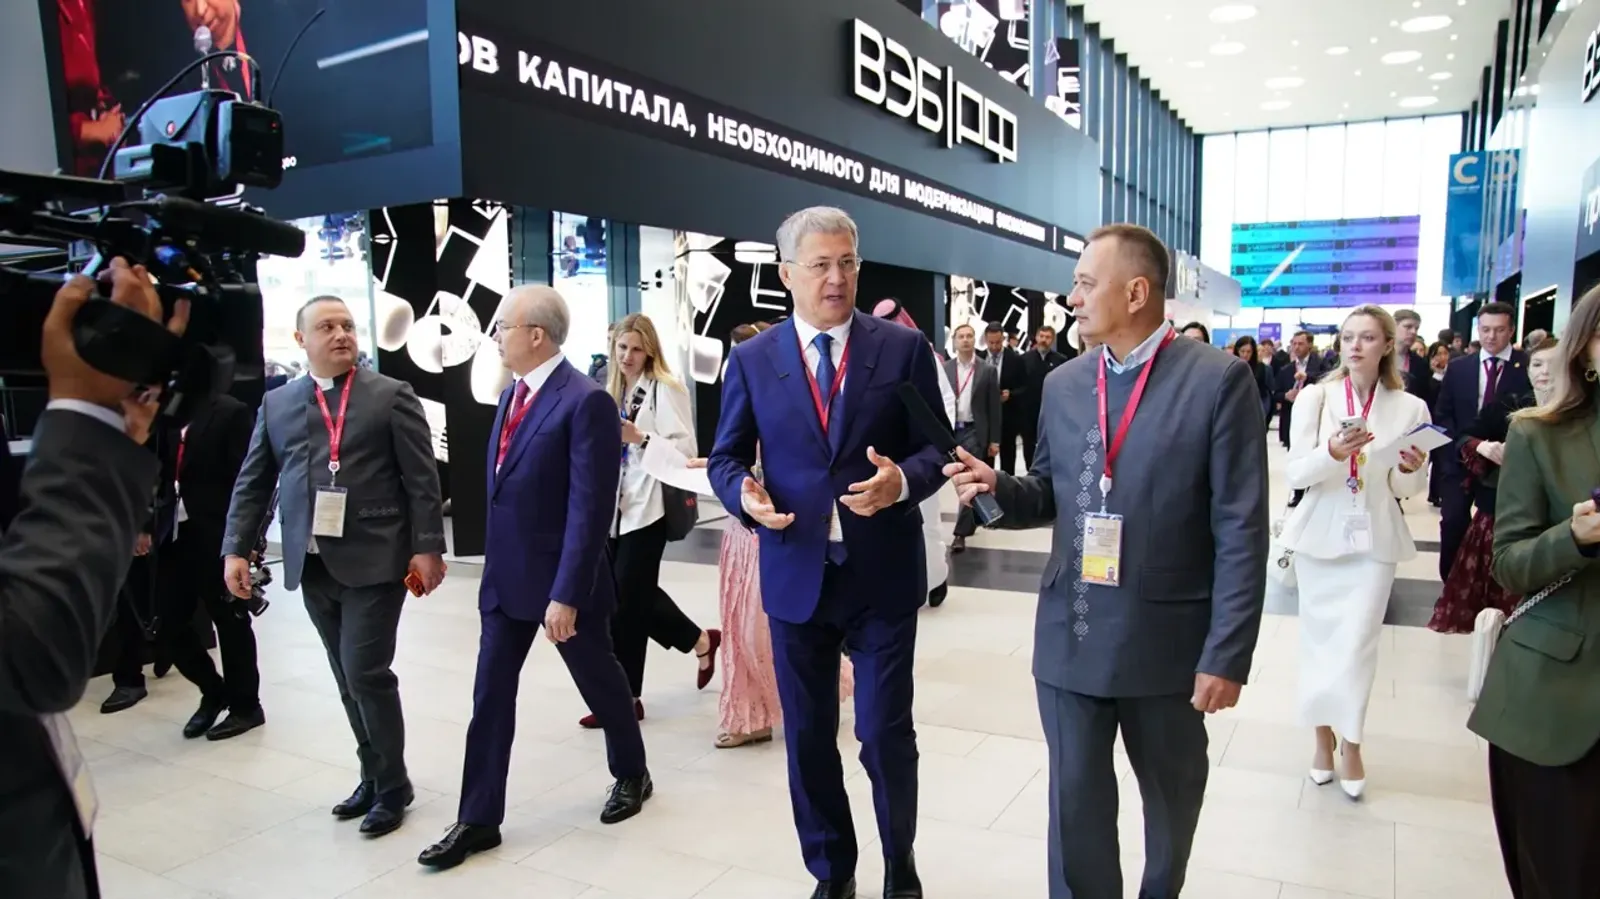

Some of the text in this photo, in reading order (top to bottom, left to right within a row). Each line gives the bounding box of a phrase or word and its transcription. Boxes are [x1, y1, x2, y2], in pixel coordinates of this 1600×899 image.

[518, 50, 697, 138] КАПИТАЛА,
[707, 112, 865, 184] НЕОБХОДИМОГО
[869, 167, 900, 196] ДЛЯ
[904, 178, 995, 226] МОДЕРНИЗАЦИИ
